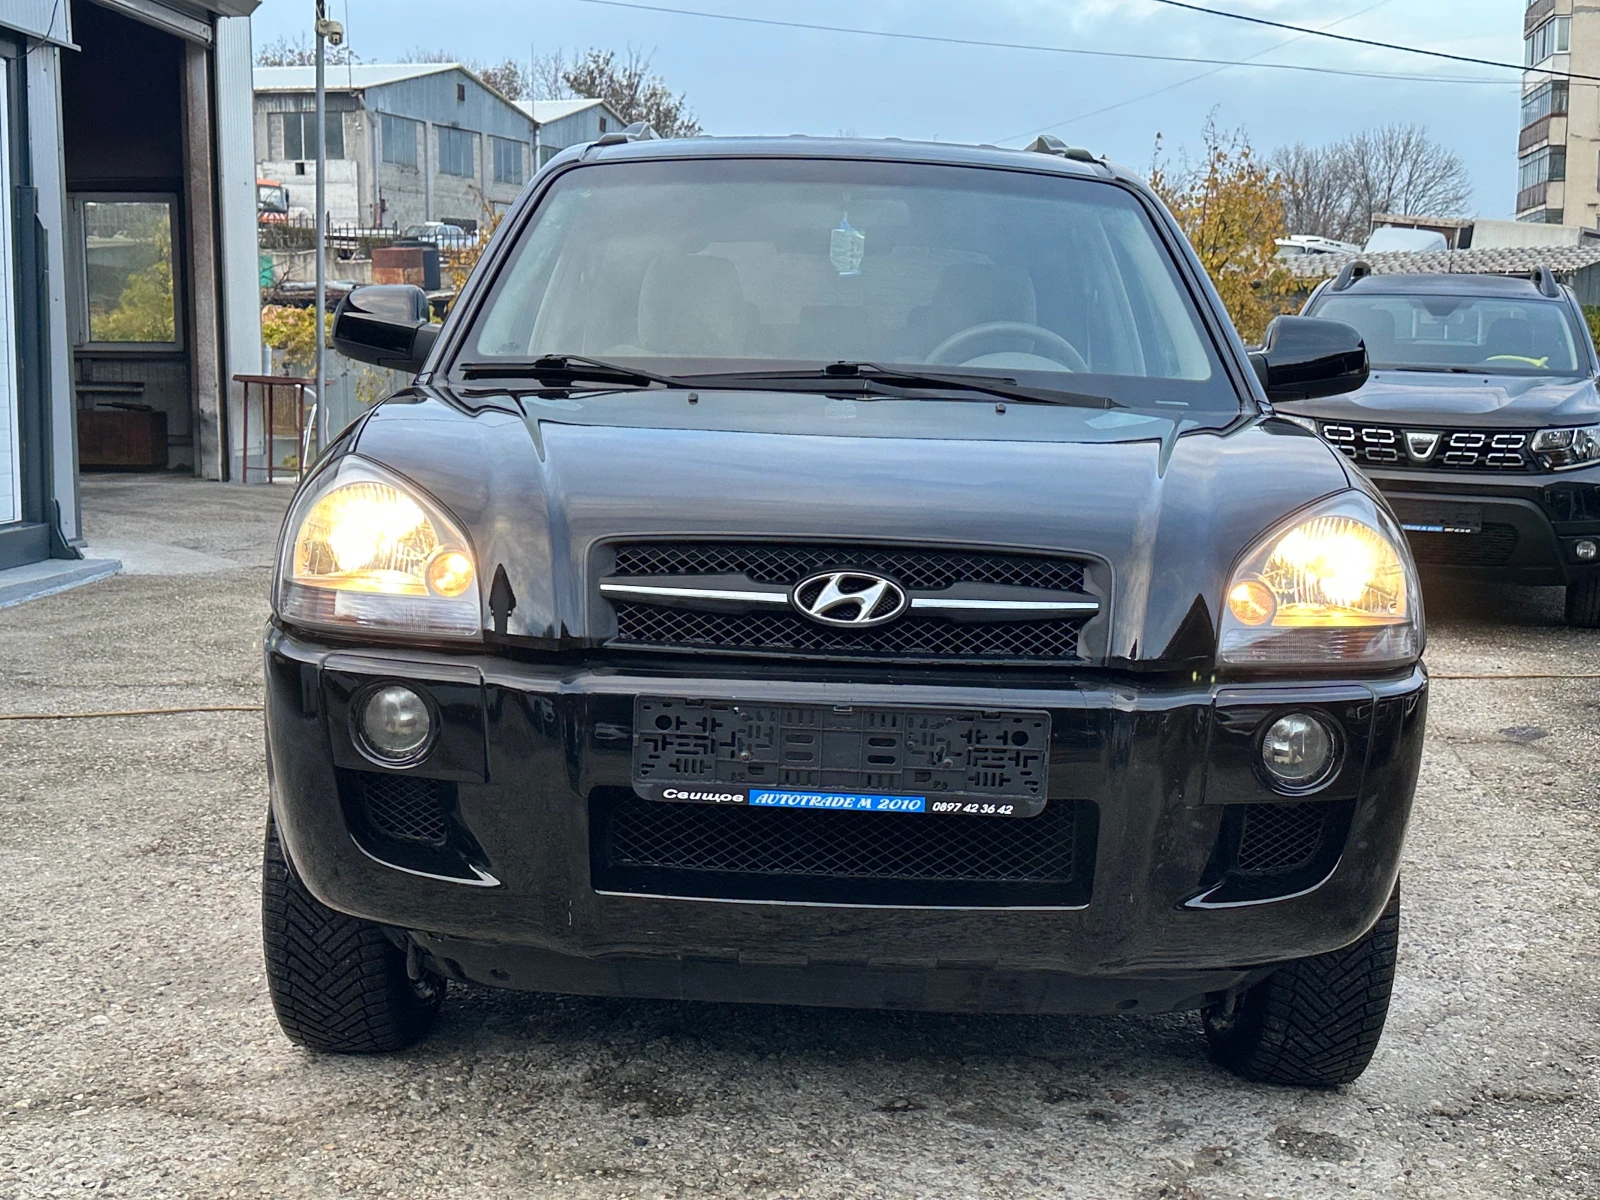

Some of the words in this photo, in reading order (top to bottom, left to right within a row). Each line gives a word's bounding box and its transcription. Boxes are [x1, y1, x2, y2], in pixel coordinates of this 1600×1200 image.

[662, 788, 744, 803] Свищов
[755, 793, 856, 808] AUTOTRADE
[857, 797, 872, 809] M
[877, 798, 921, 811] 2010
[932, 802, 962, 812] 0897
[963, 803, 979, 813] 42
[980, 804, 996, 814] 36
[997, 804, 1014, 815] 42
